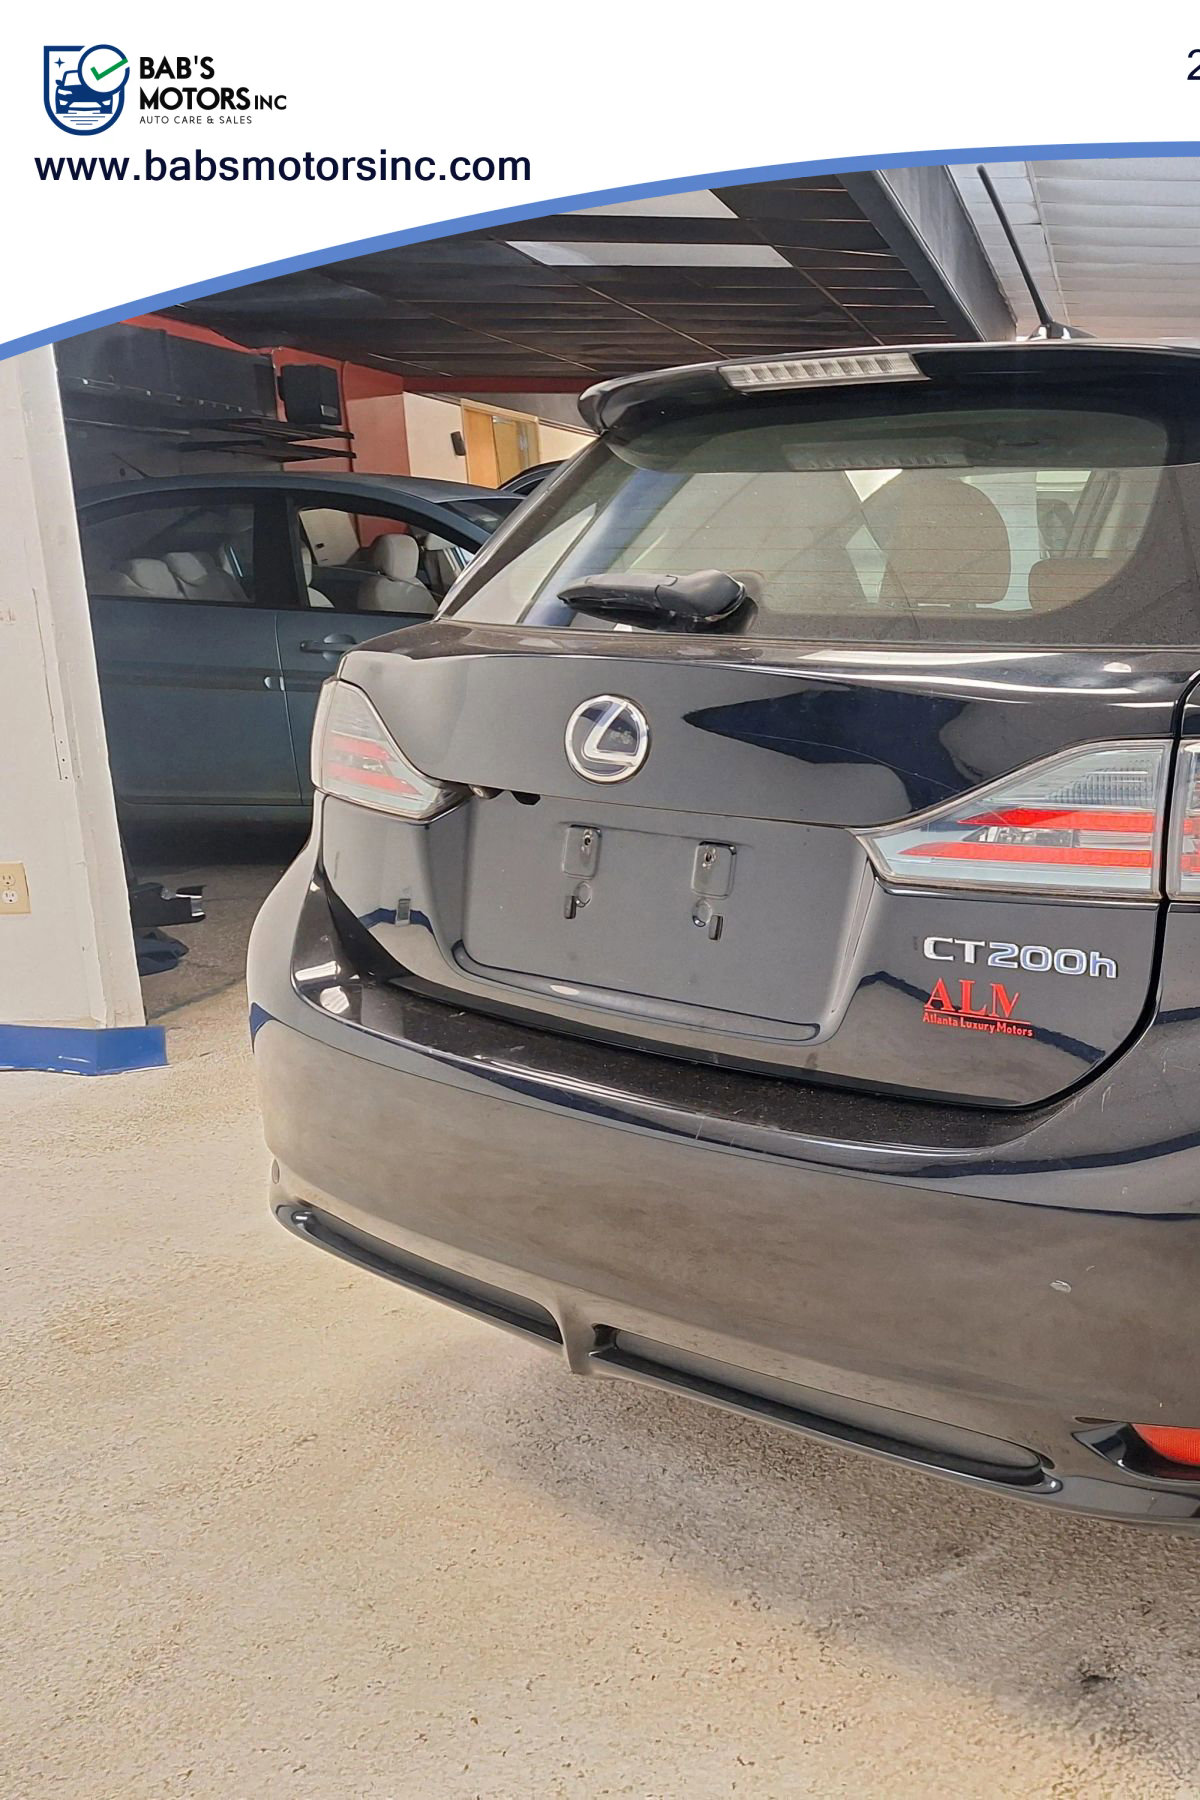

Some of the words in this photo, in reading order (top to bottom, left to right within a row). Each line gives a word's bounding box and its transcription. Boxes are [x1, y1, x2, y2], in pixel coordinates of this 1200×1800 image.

[923, 936, 1118, 979] CT200h
[922, 1012, 959, 1027] Atlanta
[960, 1017, 996, 1034] Luxury
[996, 1021, 1034, 1037] Motors
